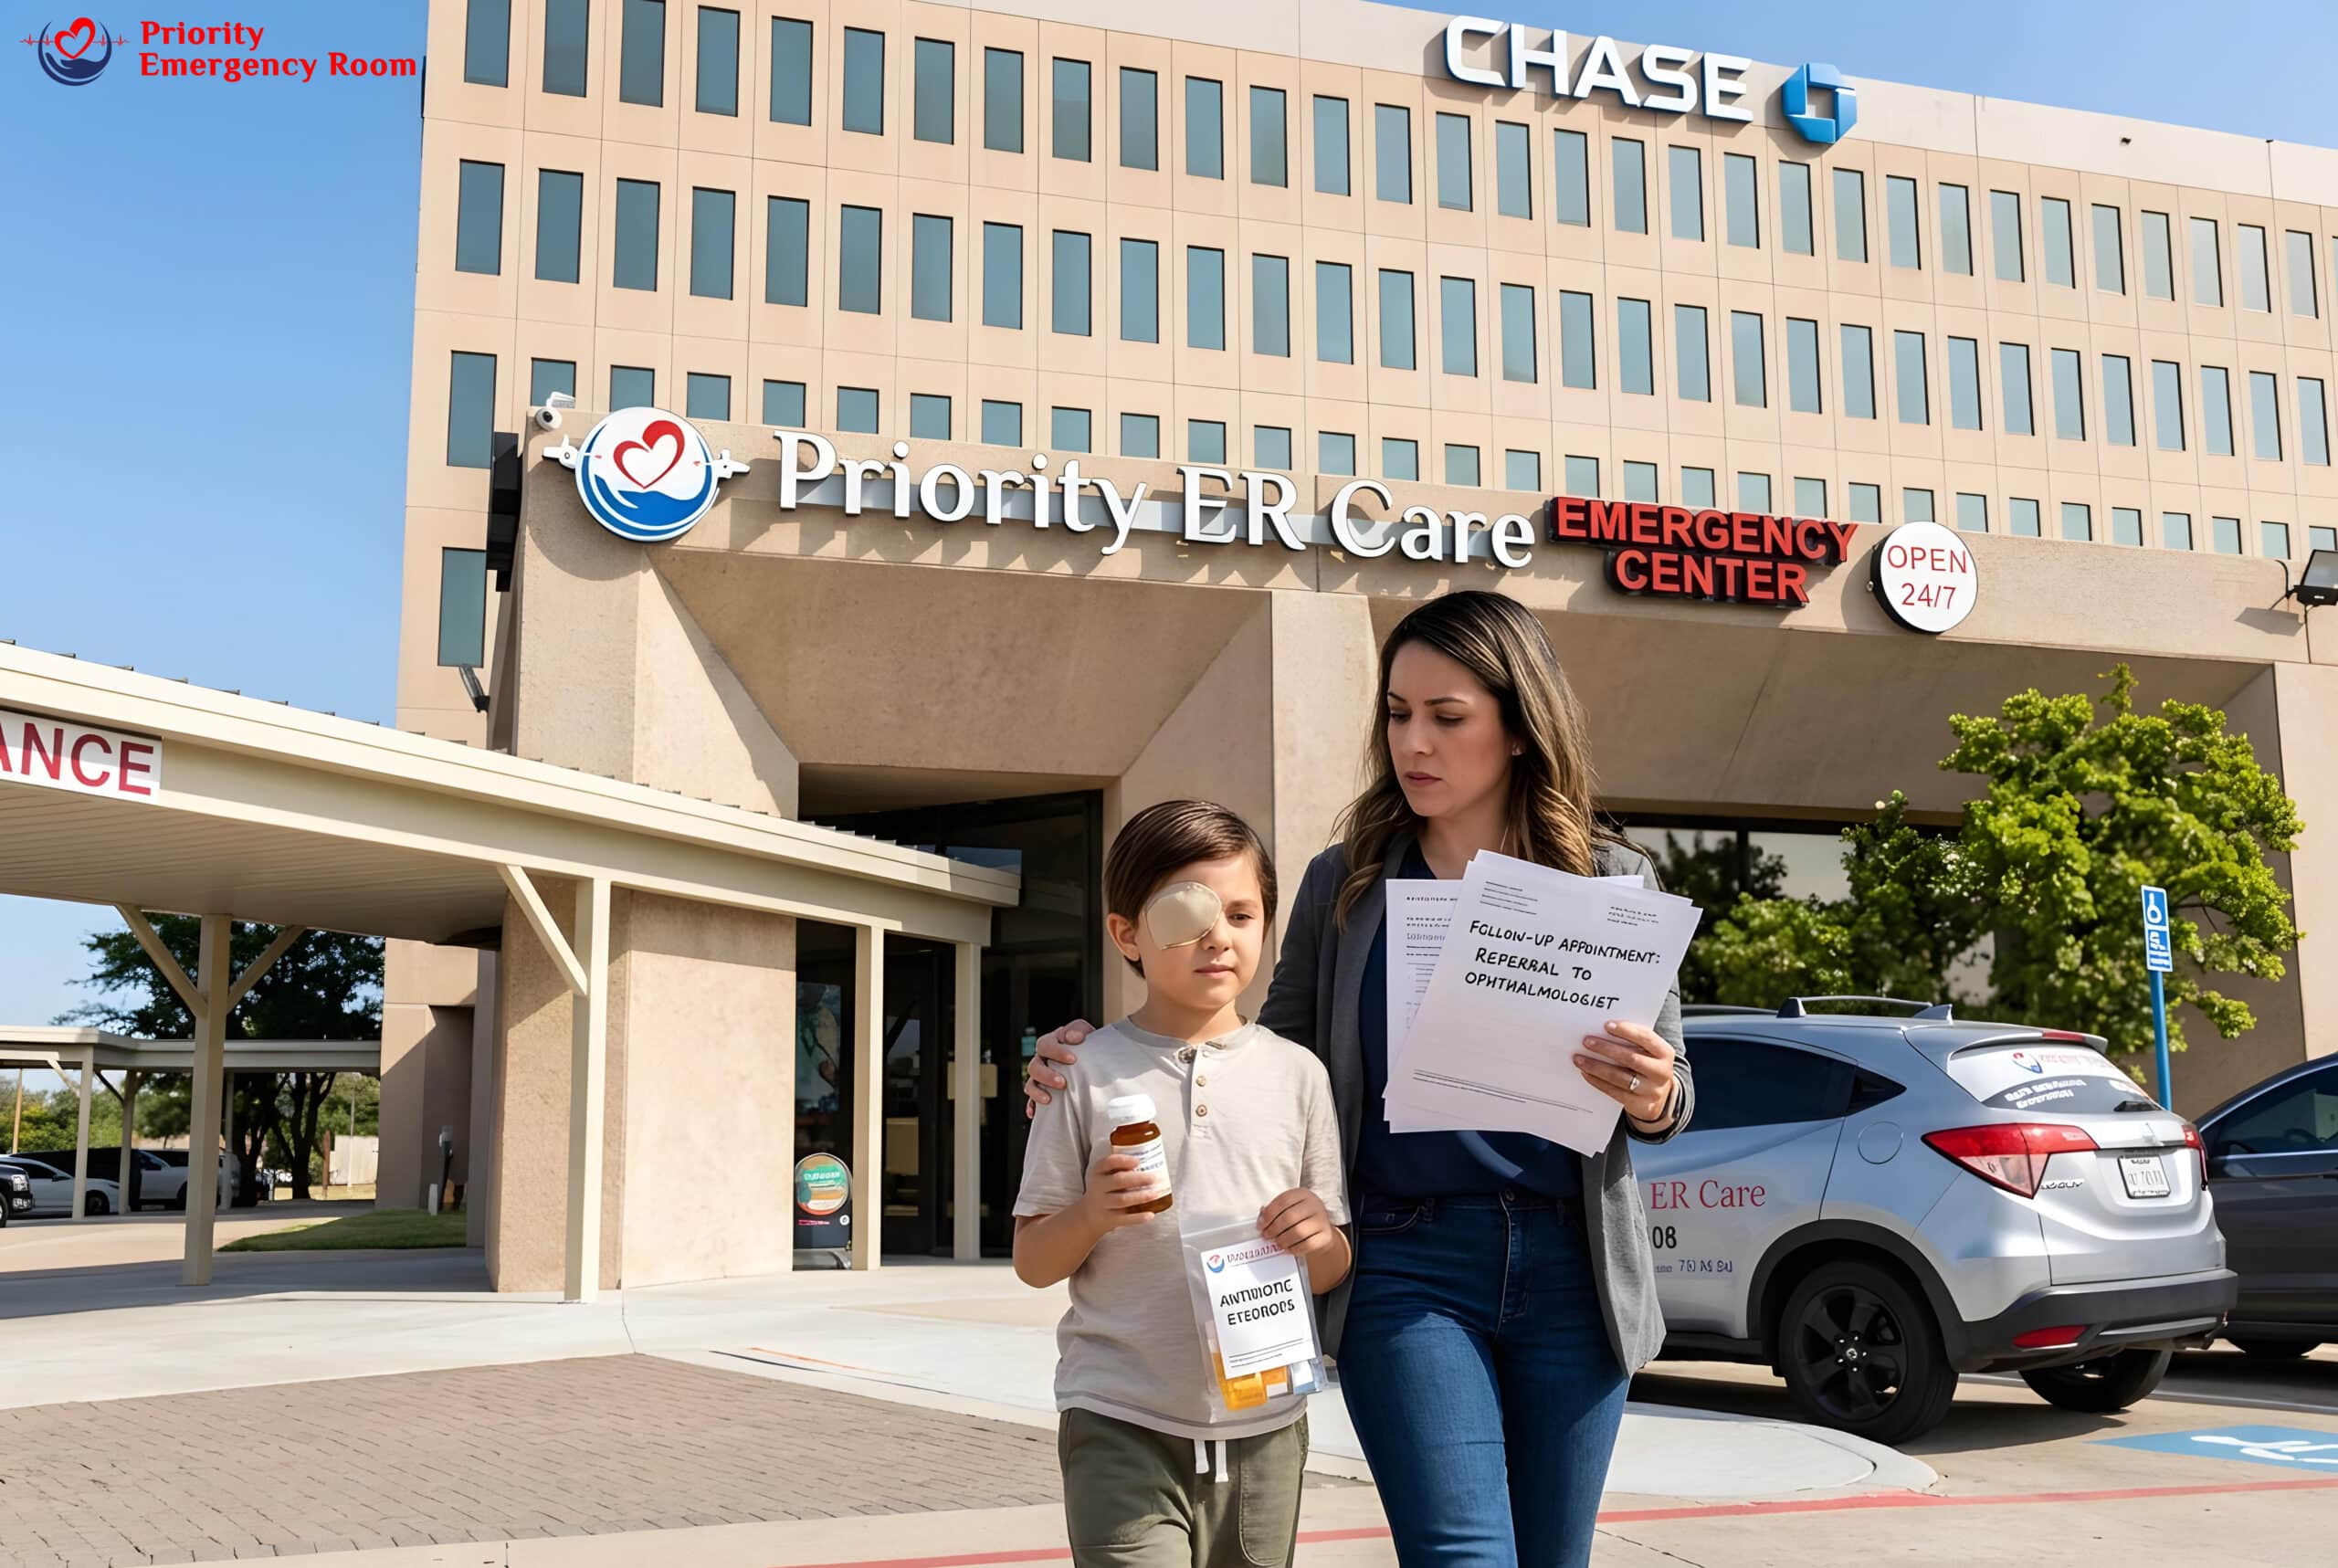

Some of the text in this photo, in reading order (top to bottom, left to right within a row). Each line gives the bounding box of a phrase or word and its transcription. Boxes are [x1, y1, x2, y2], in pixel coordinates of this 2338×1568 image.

[1445, 15, 1754, 122] CHASE
[774, 430, 1535, 569] Priority ER Care
[1555, 496, 1859, 563] EMERGENCY
[1887, 544, 1967, 574] OPEN
[1615, 549, 1810, 604] CENTER
[1901, 582, 1956, 610] 24/7
[1571, 965, 1593, 981] TO
[1650, 1179, 1766, 1210] ER Care
[1652, 1226, 1677, 1248] 08
